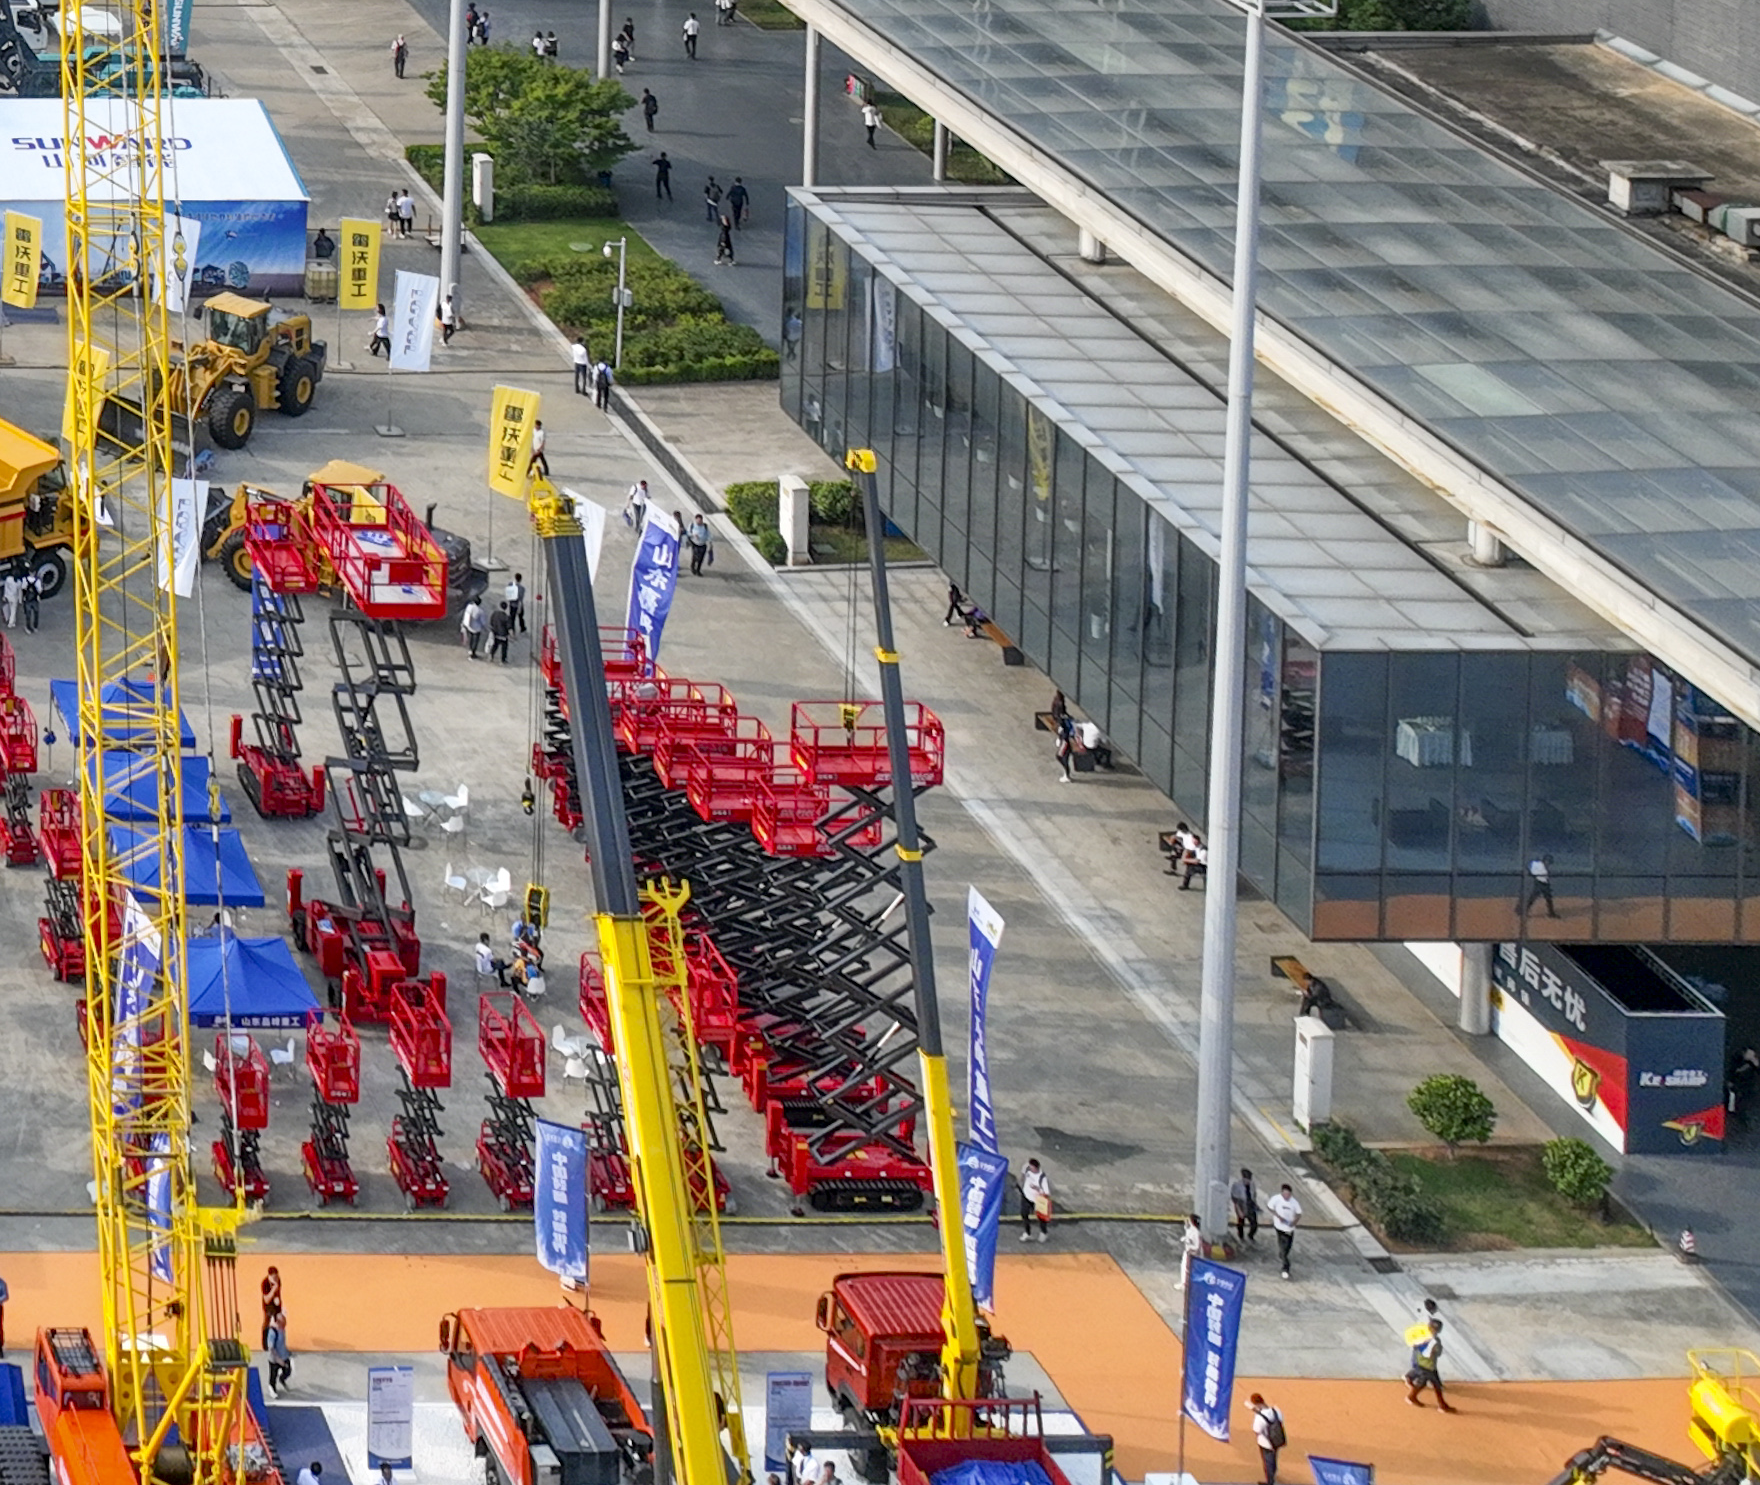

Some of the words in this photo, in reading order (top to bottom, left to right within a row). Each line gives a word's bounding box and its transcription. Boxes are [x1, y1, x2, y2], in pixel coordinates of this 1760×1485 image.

[14, 227, 32, 295] 雷沃重工
[351, 232, 369, 299] 雷沃重工
